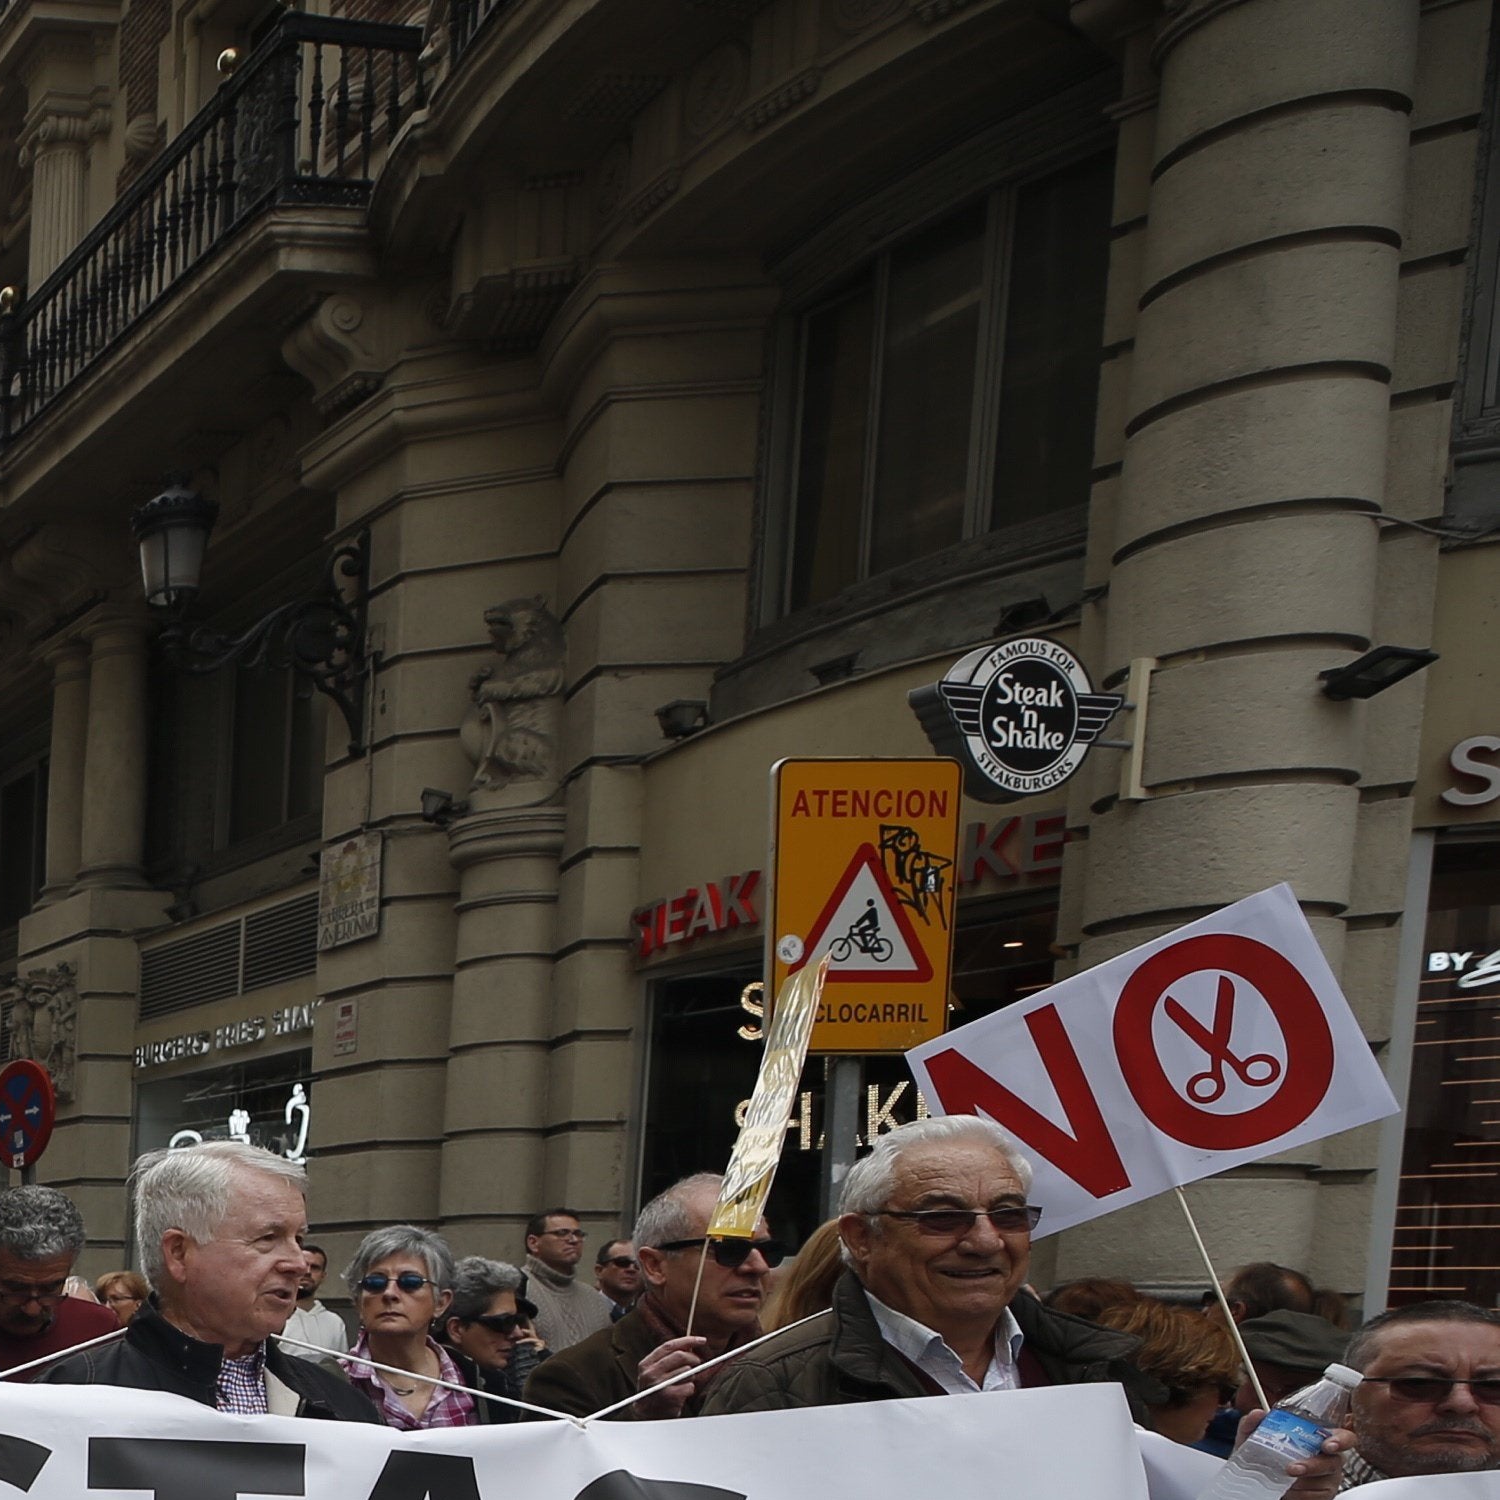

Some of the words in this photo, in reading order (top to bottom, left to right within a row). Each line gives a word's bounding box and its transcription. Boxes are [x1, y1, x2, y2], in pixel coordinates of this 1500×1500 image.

[990, 641, 1047, 668] FAMOUS
[1050, 648, 1076, 675] FOR
[996, 672, 1065, 708] Steak
[990, 715, 1065, 751] Shake
[977, 752, 1075, 791] STEAKBURGERS
[791, 789, 949, 819] ATENCION
[630, 869, 762, 956] STEAK
[1427, 951, 1473, 973] BY
[815, 1002, 929, 1023] CLOCARRIL
[135, 1031, 211, 1068] BURGERS
[215, 1016, 266, 1049] FRIES
[923, 933, 1334, 1198] NO
